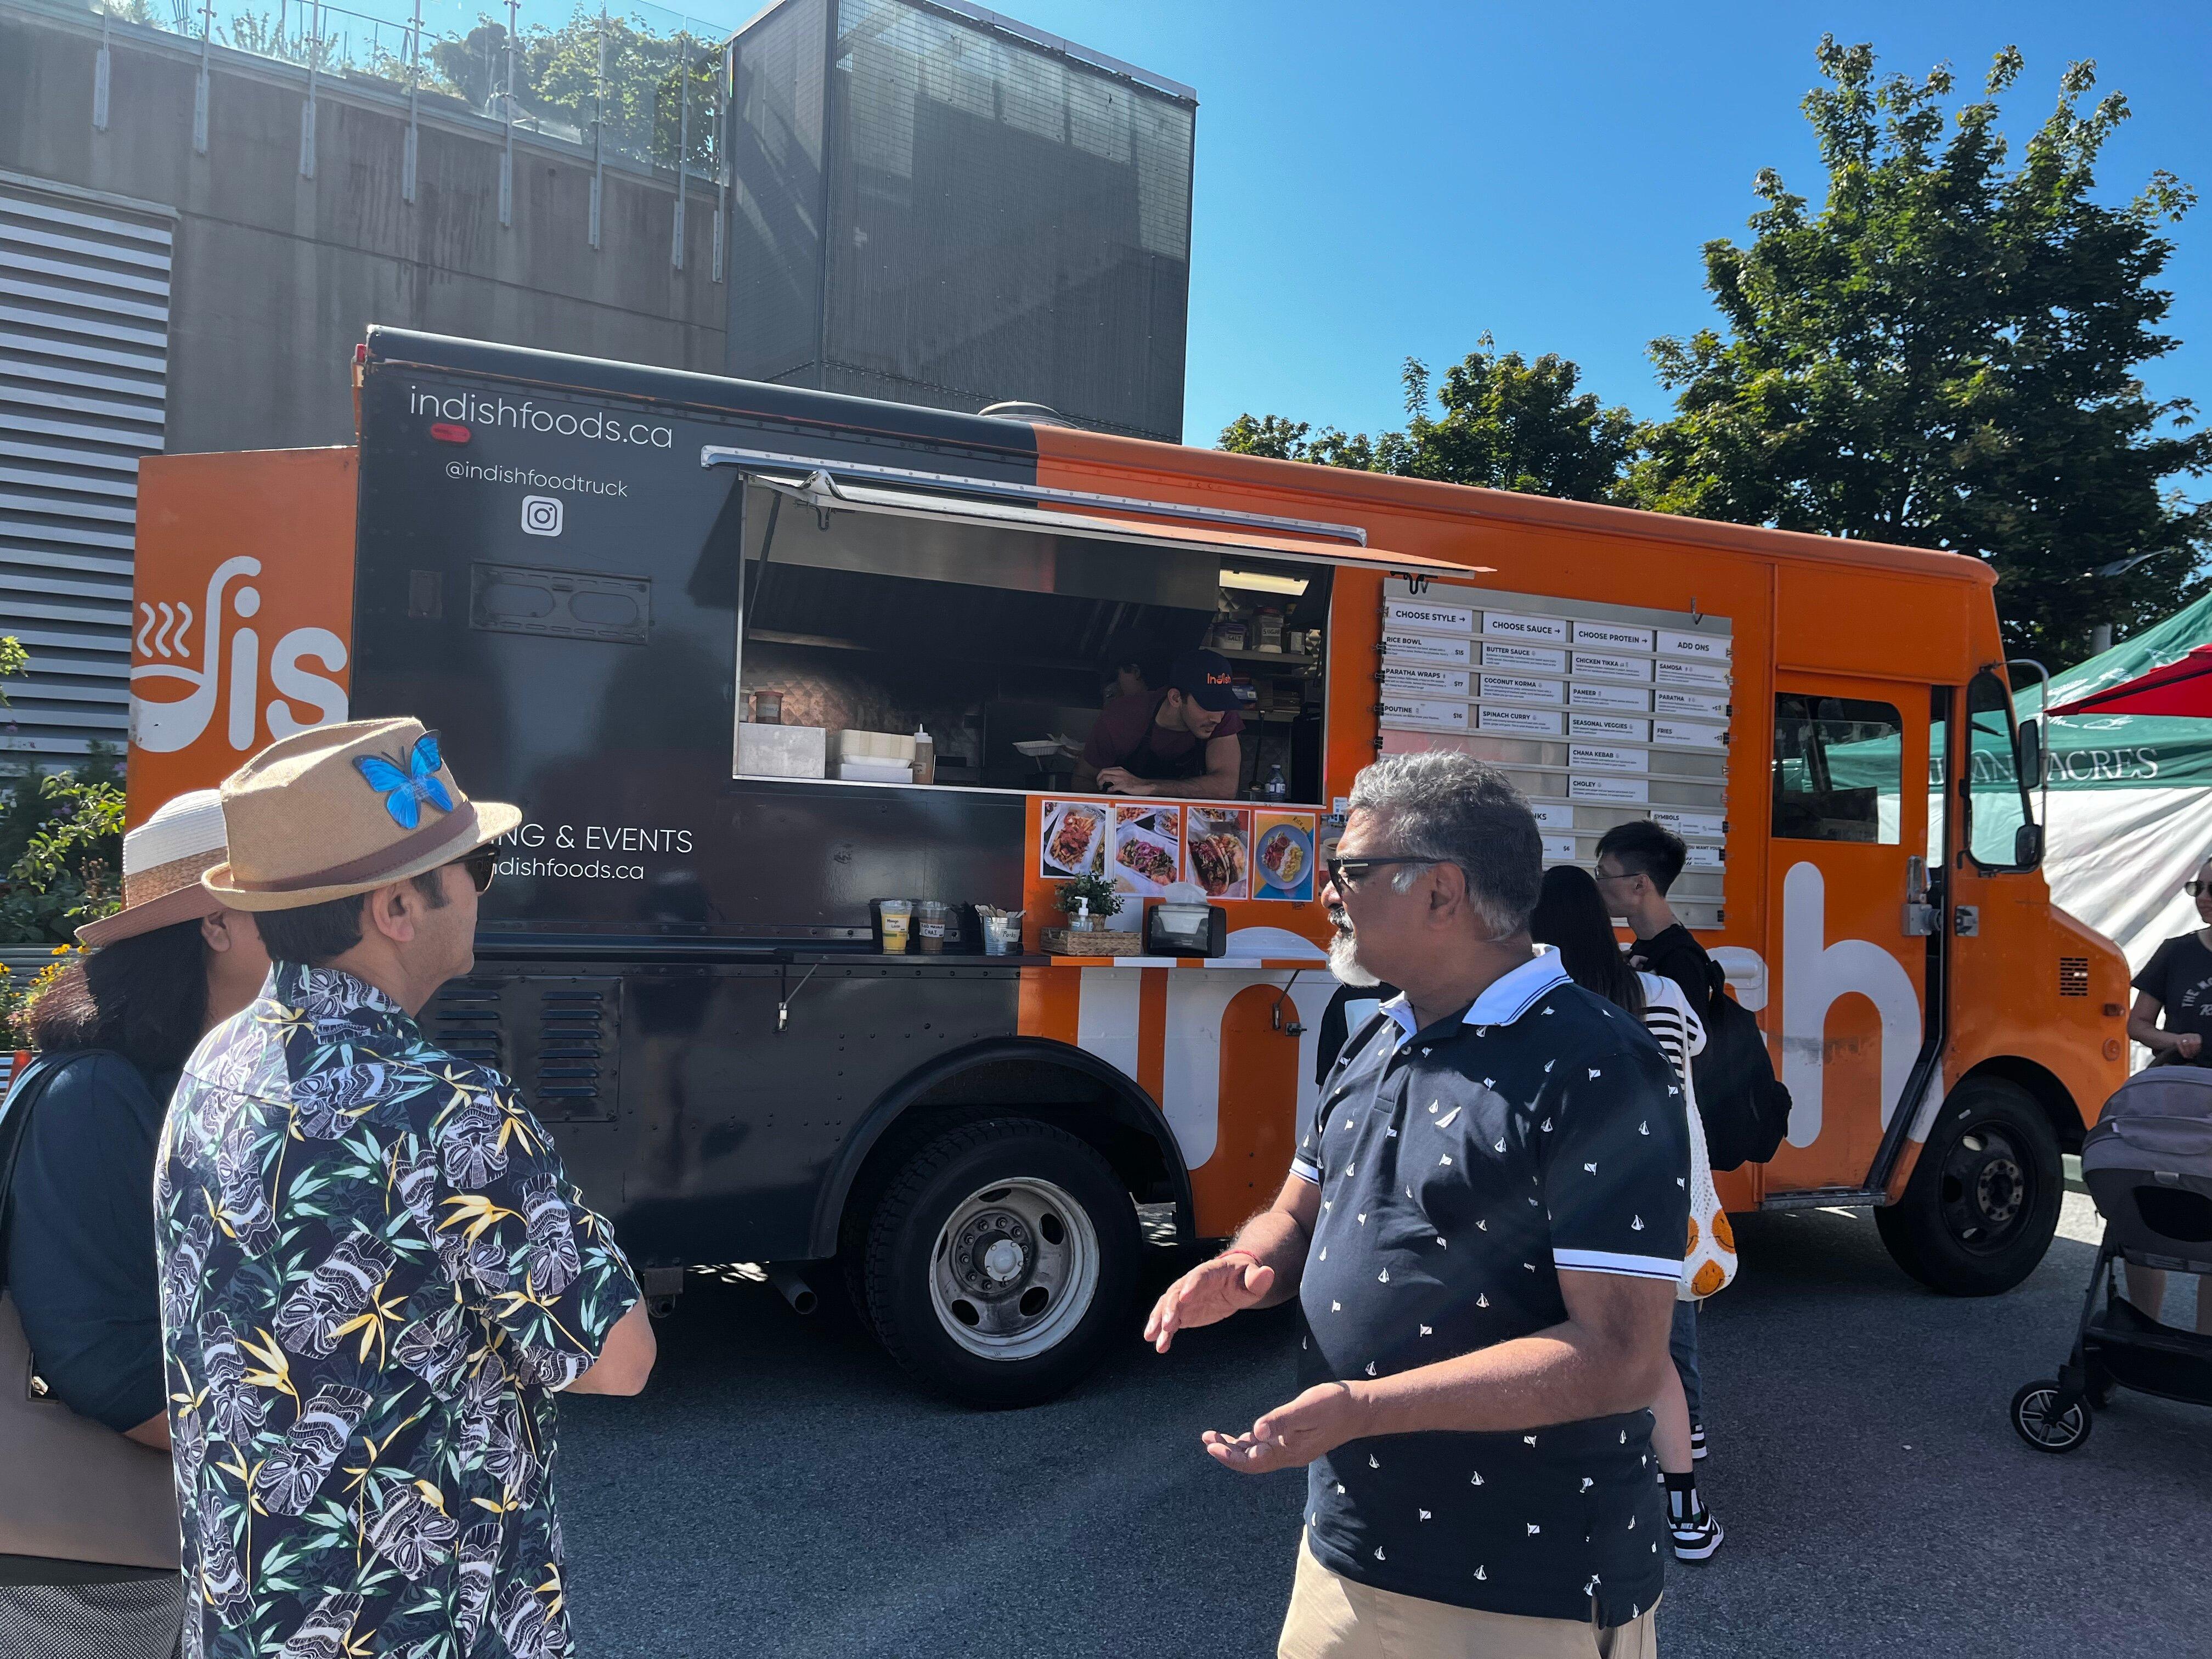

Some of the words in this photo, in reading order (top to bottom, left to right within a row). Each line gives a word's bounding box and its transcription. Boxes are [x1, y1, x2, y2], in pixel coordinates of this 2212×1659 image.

[410, 386, 673, 448] indishfoods.ca
[445, 461, 628, 498] @indishfoodtruck
[1396, 610, 1430, 620] CHOOSE
[1432, 613, 1457, 622] STYLE
[1492, 621, 1525, 631] CHOOSE
[1526, 625, 1553, 634] SAUCE
[1578, 631, 1608, 640] CHOOSE
[1609, 634, 1639, 643] PROTEIN
[1678, 641, 1693, 650] ADD
[1386, 668, 1416, 676] PARATHA
[1484, 677, 1514, 685] COCONUT
[2046, 747, 2159, 781] ACRES
[1293, 816, 1304, 826] RICE
[556, 825, 575, 849] &
[586, 826, 693, 854] EVENTS
